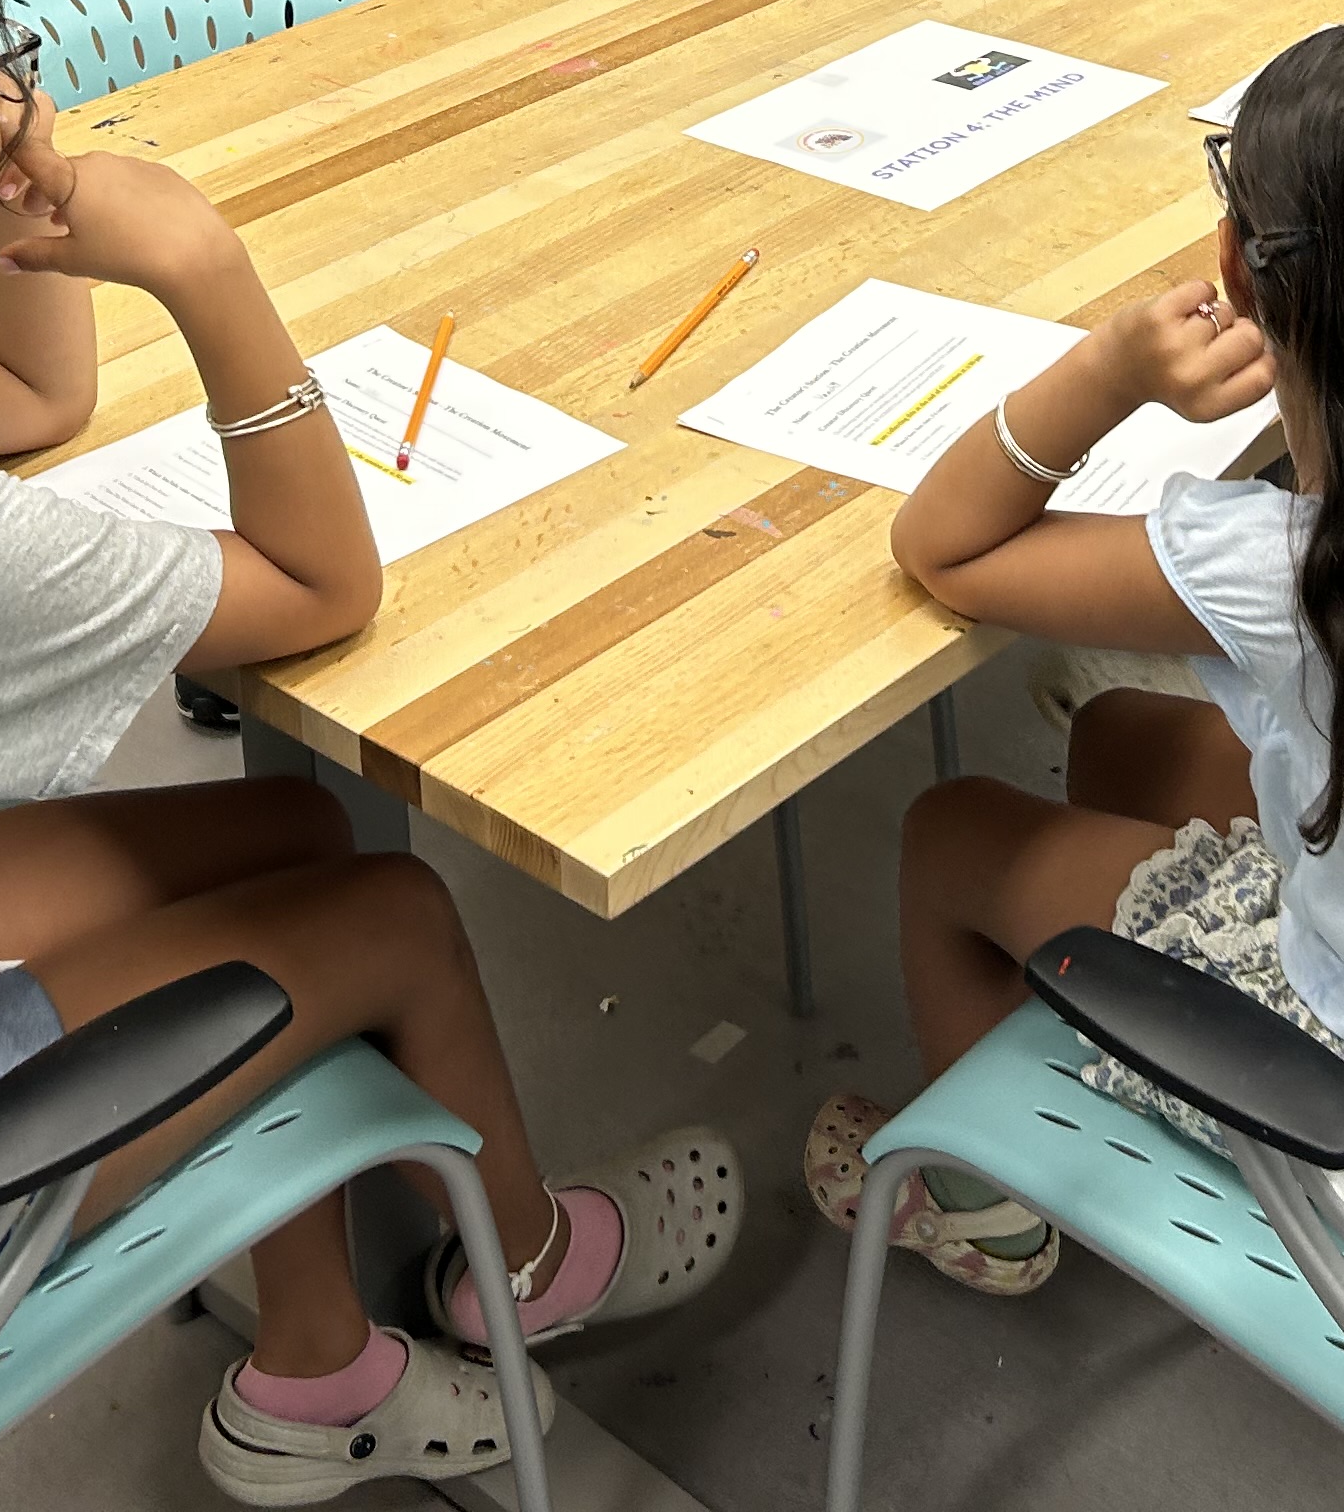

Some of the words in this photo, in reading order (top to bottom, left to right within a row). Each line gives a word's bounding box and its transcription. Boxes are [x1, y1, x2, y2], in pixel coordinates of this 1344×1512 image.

[871, 131, 969, 180] STATION
[966, 121, 991, 133] 4:
[982, 99, 1032, 121] THE
[1024, 73, 1085, 102] MIND
